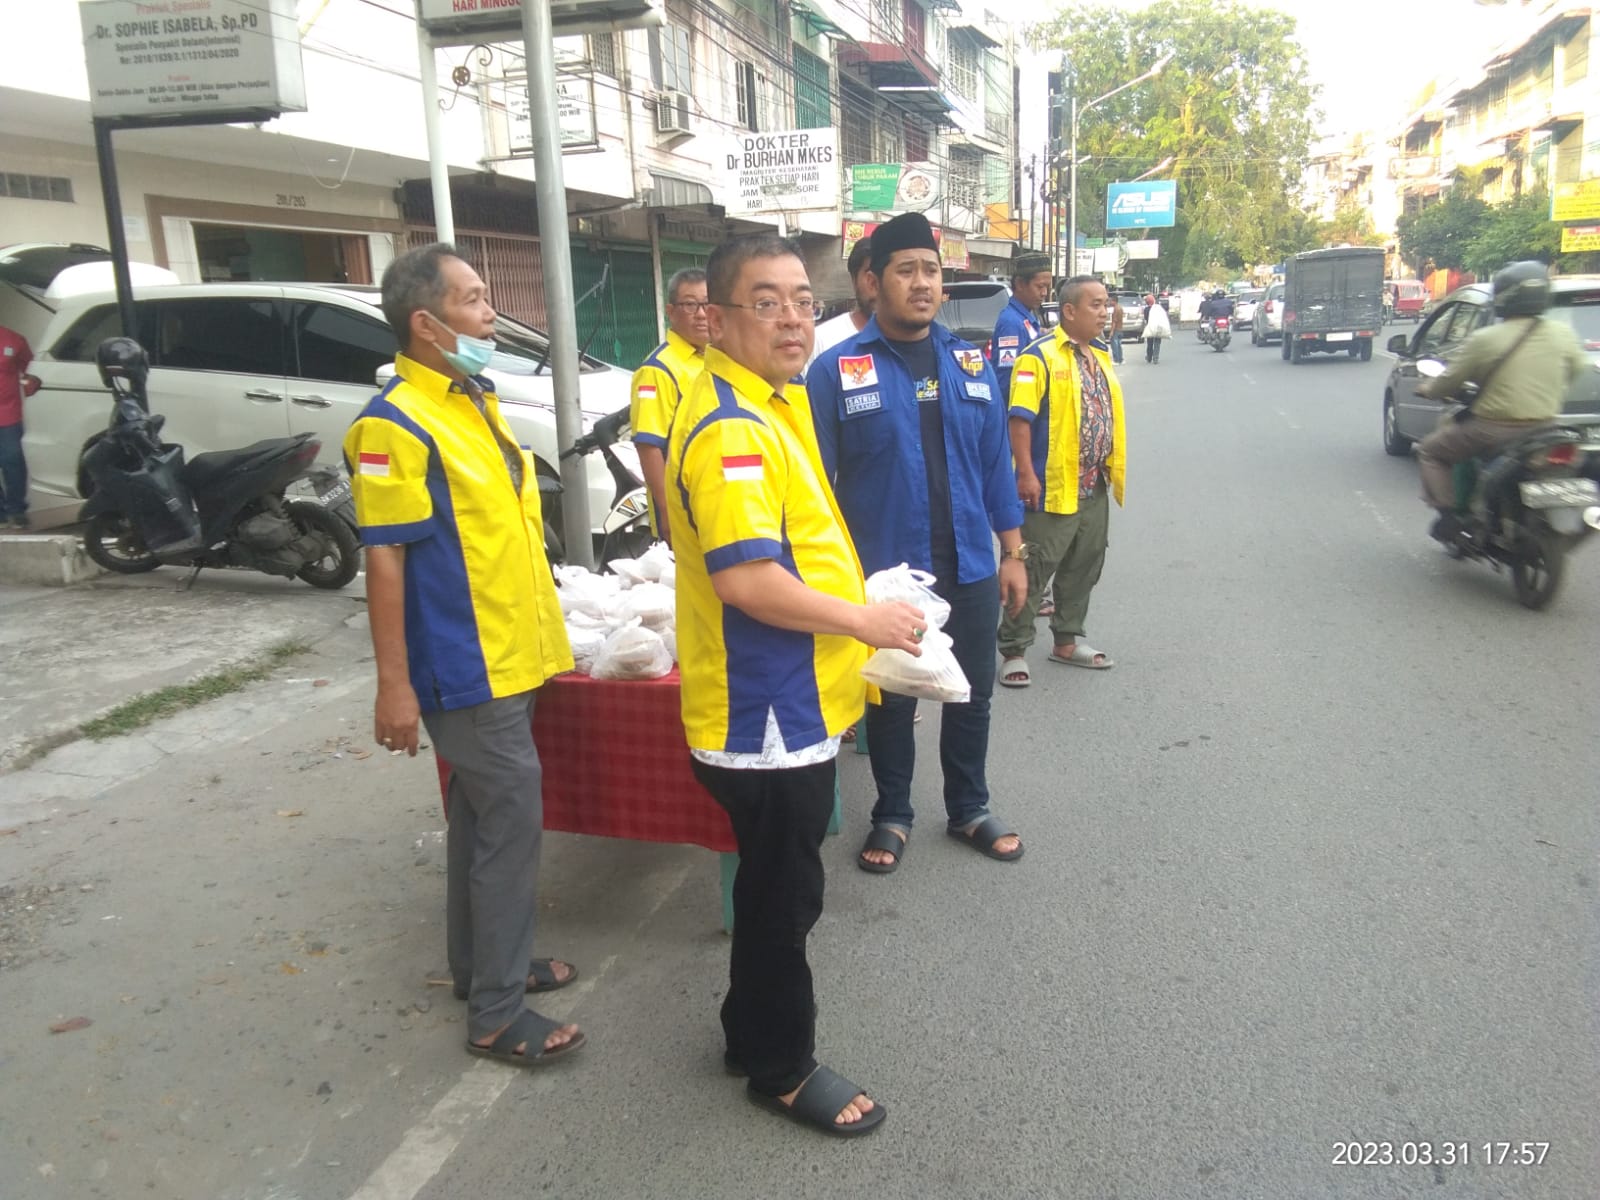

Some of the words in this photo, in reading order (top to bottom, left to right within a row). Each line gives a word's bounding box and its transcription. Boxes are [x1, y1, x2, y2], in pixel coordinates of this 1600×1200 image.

[453, 0, 477, 12] HARI
[96, 25, 112, 39] Dr.
[115, 20, 159, 38] SOPHIE
[163, 16, 218, 34] ISABELA,
[222, 13, 258, 32] Sp.PD
[745, 133, 809, 152] DOKTER
[727, 154, 740, 170] Dr
[744, 149, 794, 169] BURHAN
[798, 146, 832, 165] MKES
[740, 175, 775, 187] PRAKTEK
[775, 173, 800, 185] SETIAP
[801, 171, 819, 183] HARI
[740, 188, 758, 198] JAM
[796, 184, 820, 194] SORE
[747, 199, 763, 209] HARI
[847, 393, 879, 407] SATRIA
